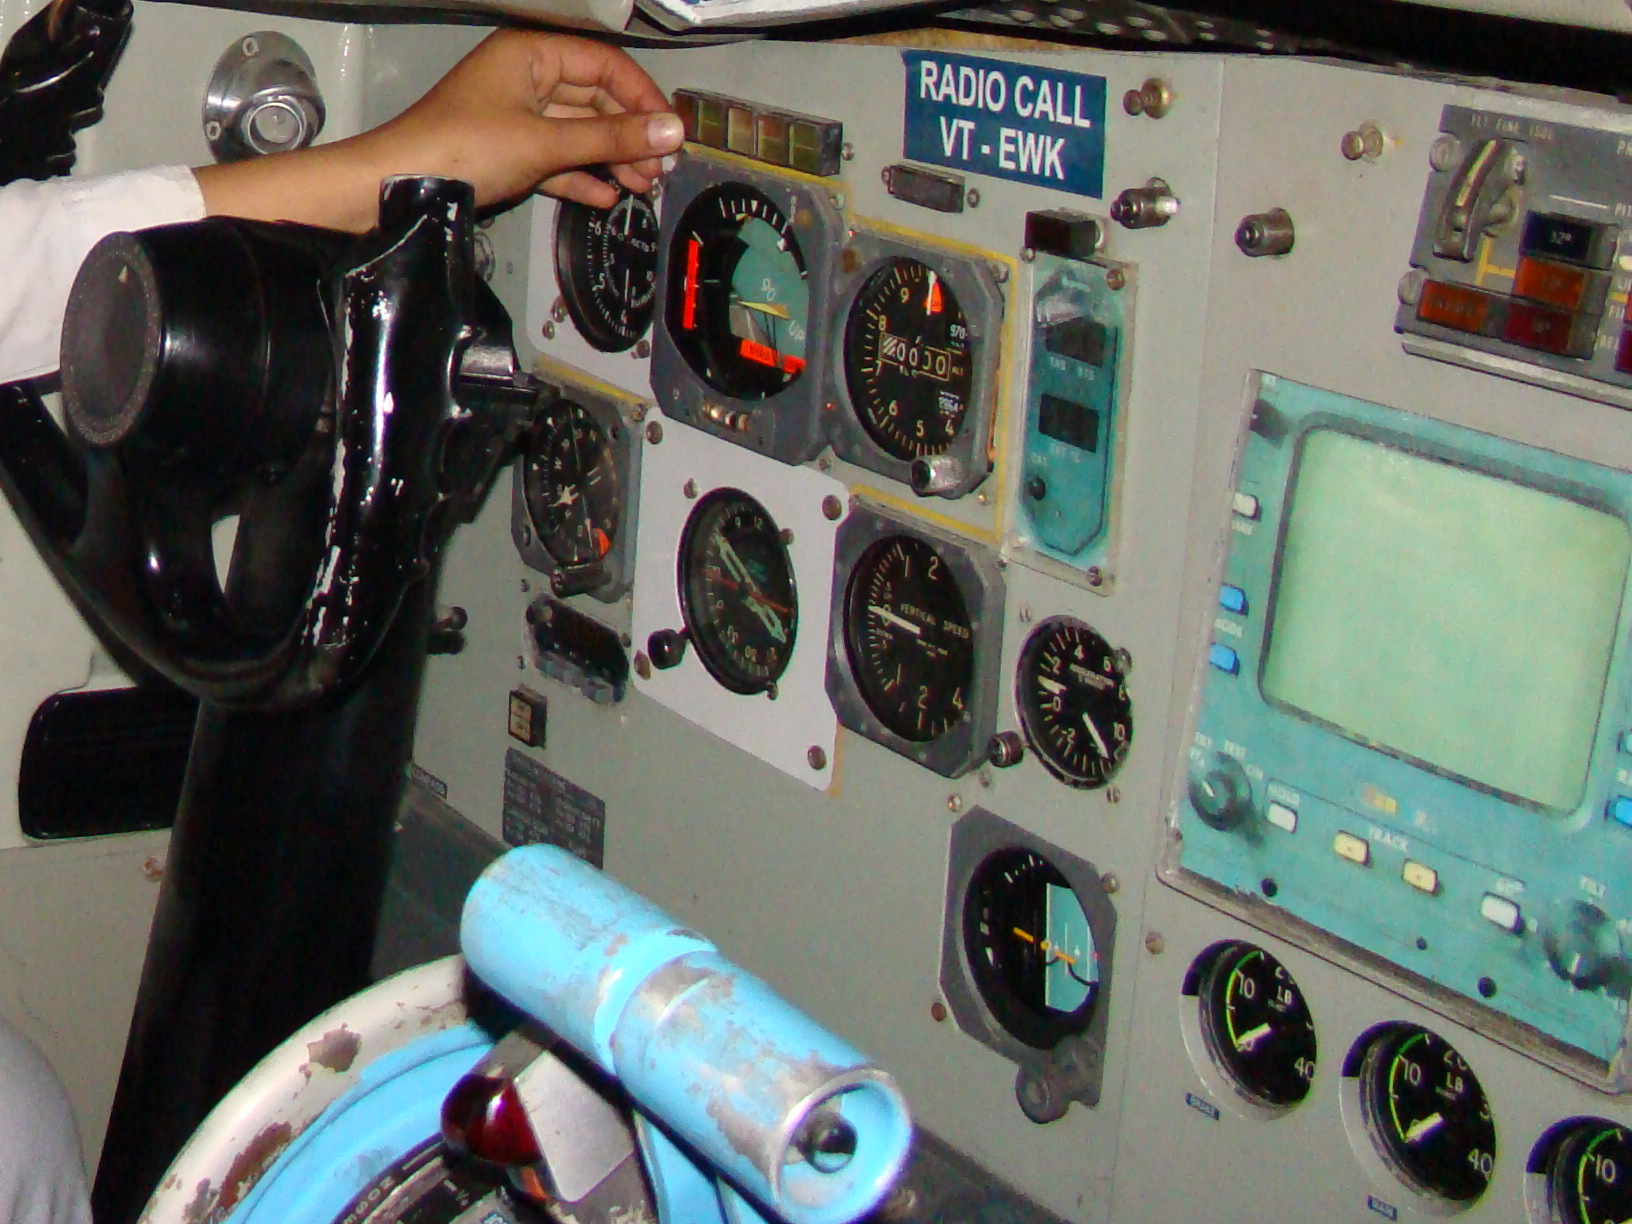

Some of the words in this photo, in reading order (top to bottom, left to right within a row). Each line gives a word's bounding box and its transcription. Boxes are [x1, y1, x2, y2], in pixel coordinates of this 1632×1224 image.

[920, 60, 1006, 112] RADIO
[1015, 76, 1090, 128] CALL
[940, 116, 975, 160] VT
[999, 127, 1065, 180] EWK
[900, 287, 910, 304] 9
[879, 315, 887, 332] 8
[889, 400, 898, 417] 6
[916, 420, 925, 437] 5
[944, 419, 955, 437] 4
[928, 556, 938, 580] 2
[900, 603, 937, 626] VERTICAL
[943, 620, 970, 640] SPEED
[1074, 644, 1084, 660] 4
[1053, 656, 1061, 675] 2
[1103, 656, 1112, 672] 6
[918, 685, 928, 710] 2
[952, 687, 964, 710] 4
[1052, 696, 1061, 712] 0
[1238, 972, 1255, 999] 10
[1294, 1056, 1315, 1078] 40
[1402, 1059, 1421, 1085] 10
[1468, 1148, 1493, 1171] 40
[1595, 1153, 1616, 1183] 10
